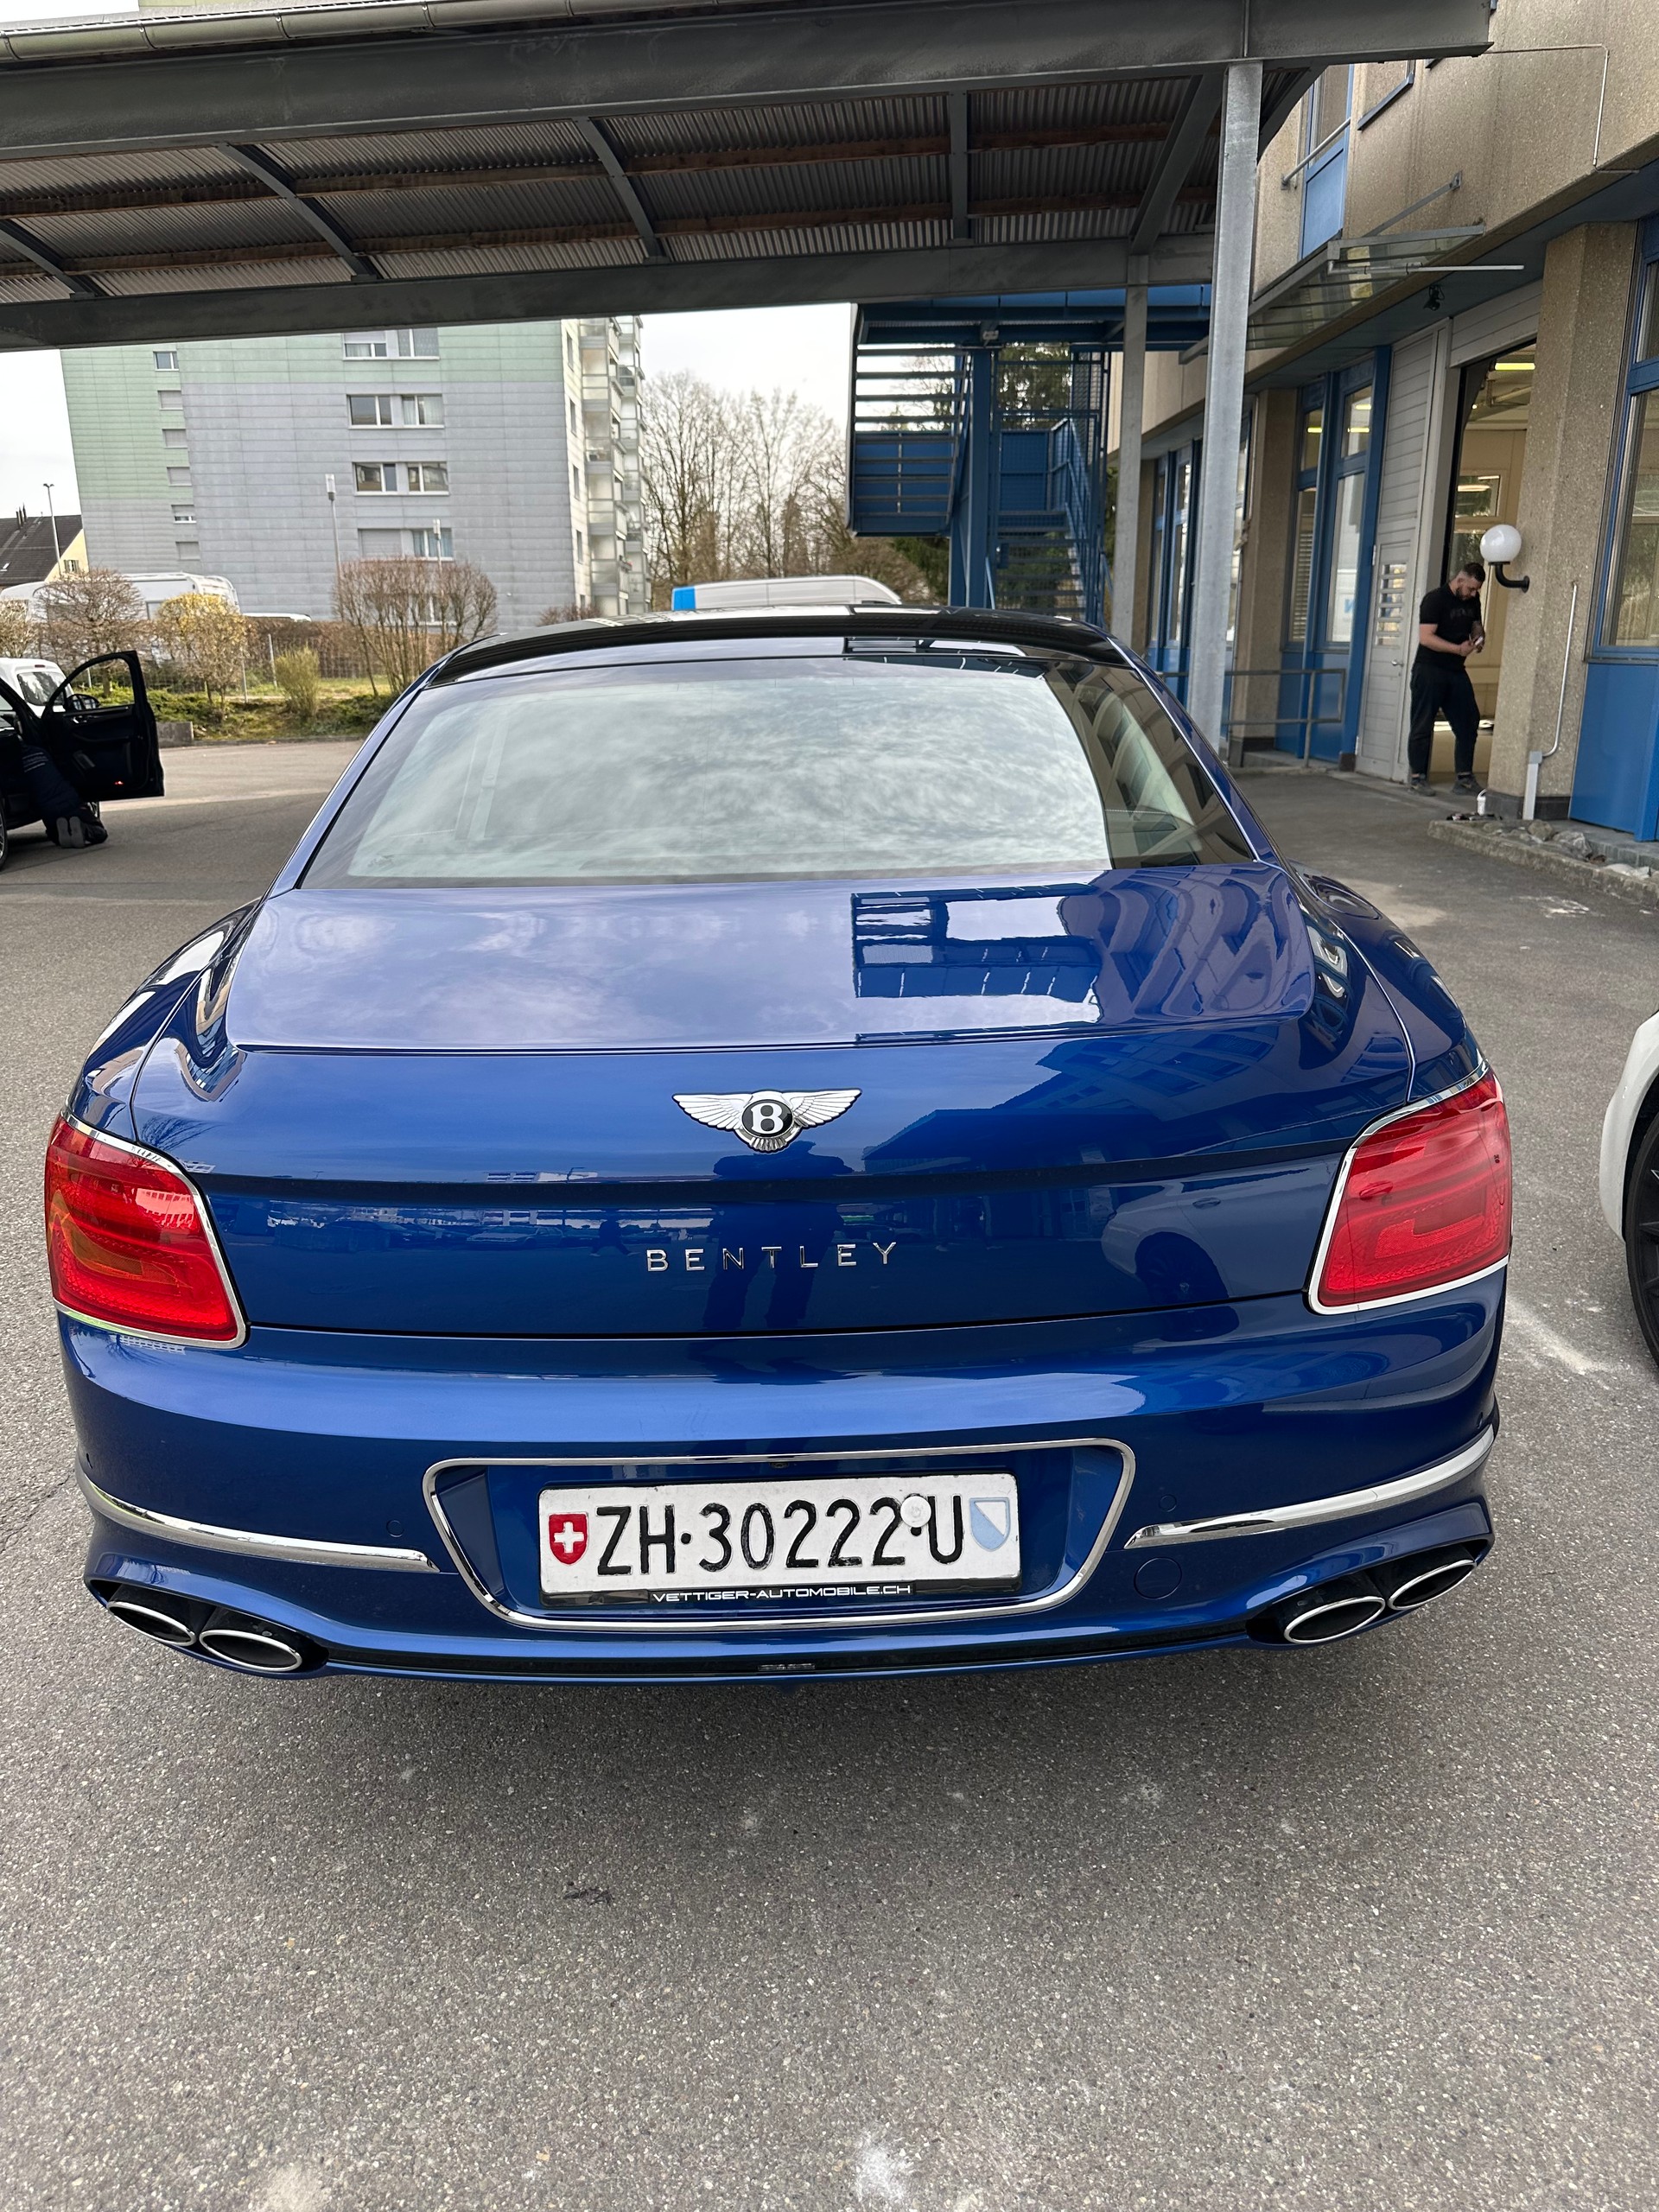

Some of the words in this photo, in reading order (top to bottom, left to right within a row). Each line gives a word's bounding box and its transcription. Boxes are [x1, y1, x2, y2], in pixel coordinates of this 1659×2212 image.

[749, 1104, 784, 1135] B
[646, 1242, 896, 1272] BENTLEY
[652, 1585, 911, 1603] VETTIGER-AUTOMOBILE.CH
